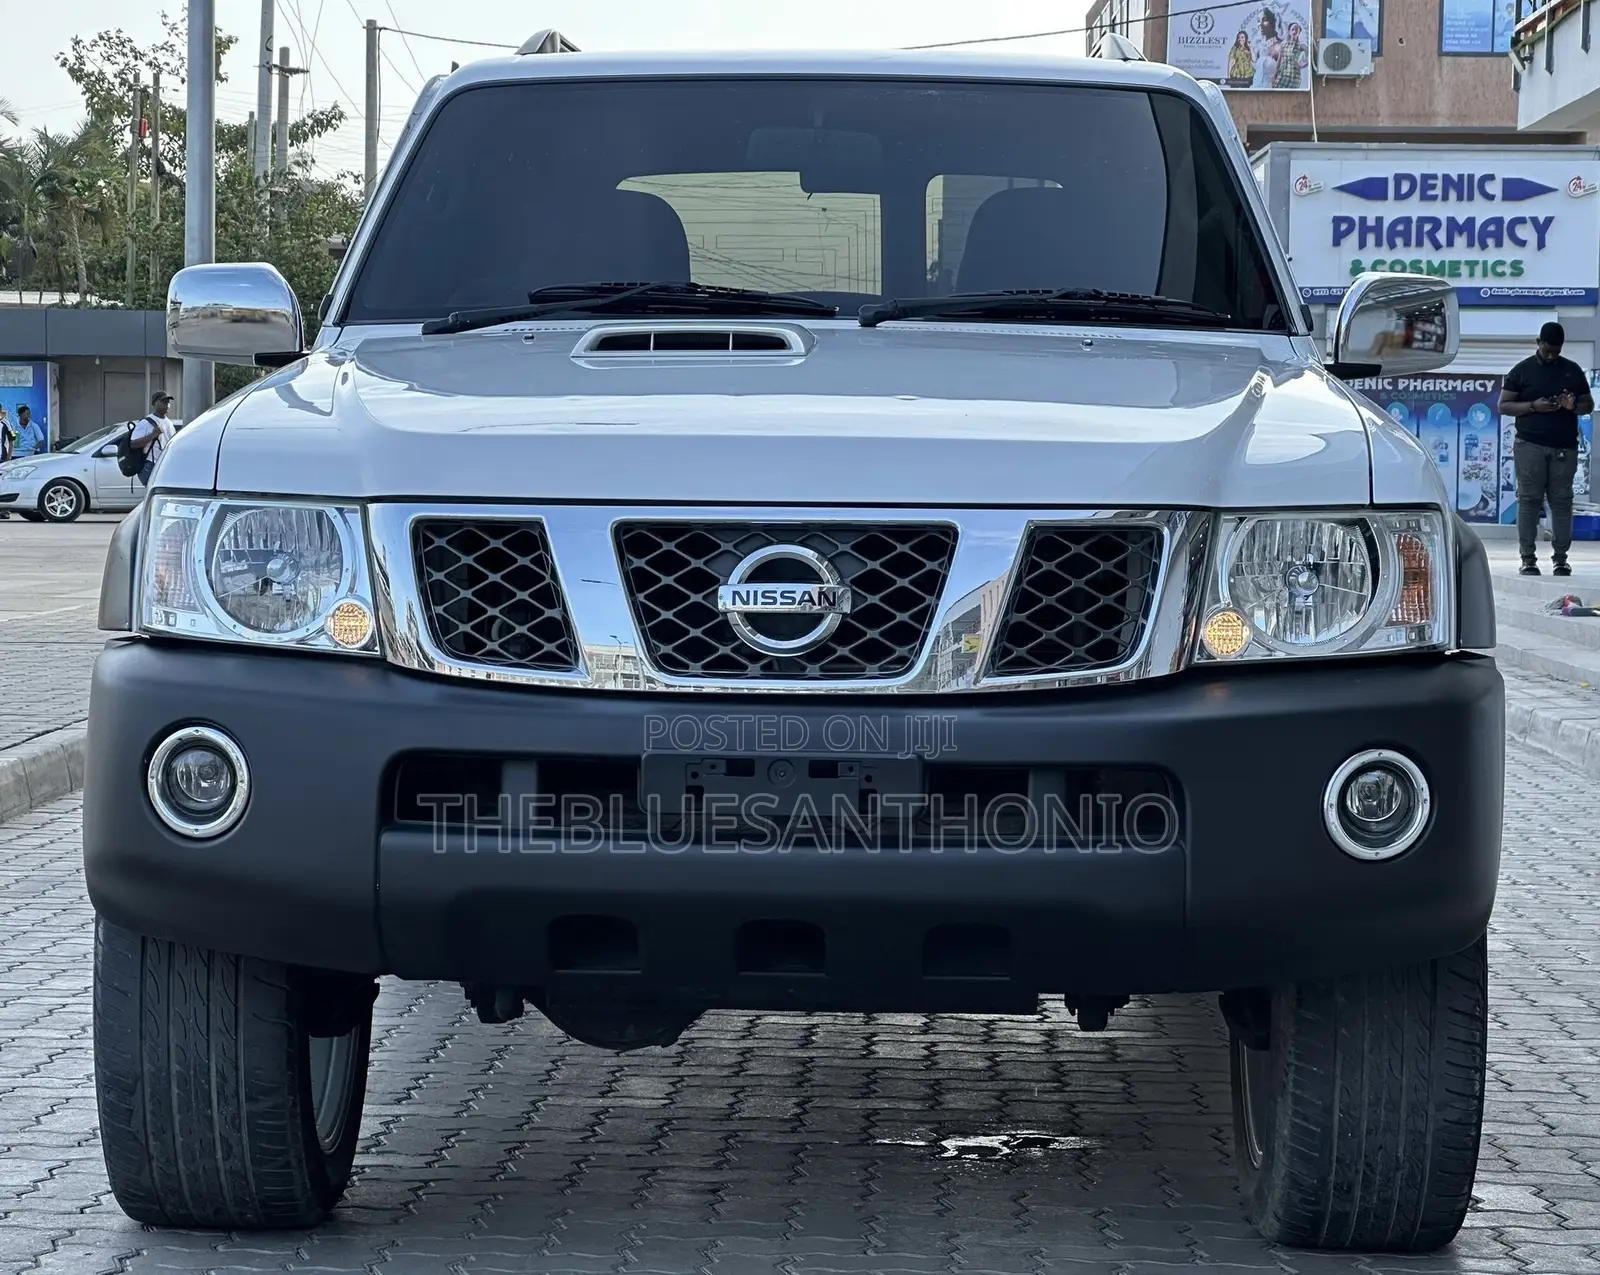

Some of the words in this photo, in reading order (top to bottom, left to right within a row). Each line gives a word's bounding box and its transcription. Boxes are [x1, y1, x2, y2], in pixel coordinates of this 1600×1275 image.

[1178, 36, 1228, 45] BIZZLEST
[1393, 173, 1496, 201] DENIC
[1332, 215, 1555, 251] PHARMACY
[1350, 259, 1366, 277] &
[1370, 259, 1525, 278] COSMETICS
[1398, 379, 1496, 393] PHARMACY
[1391, 391, 1457, 400] COSMETICS
[731, 590, 837, 607] NISSAN
